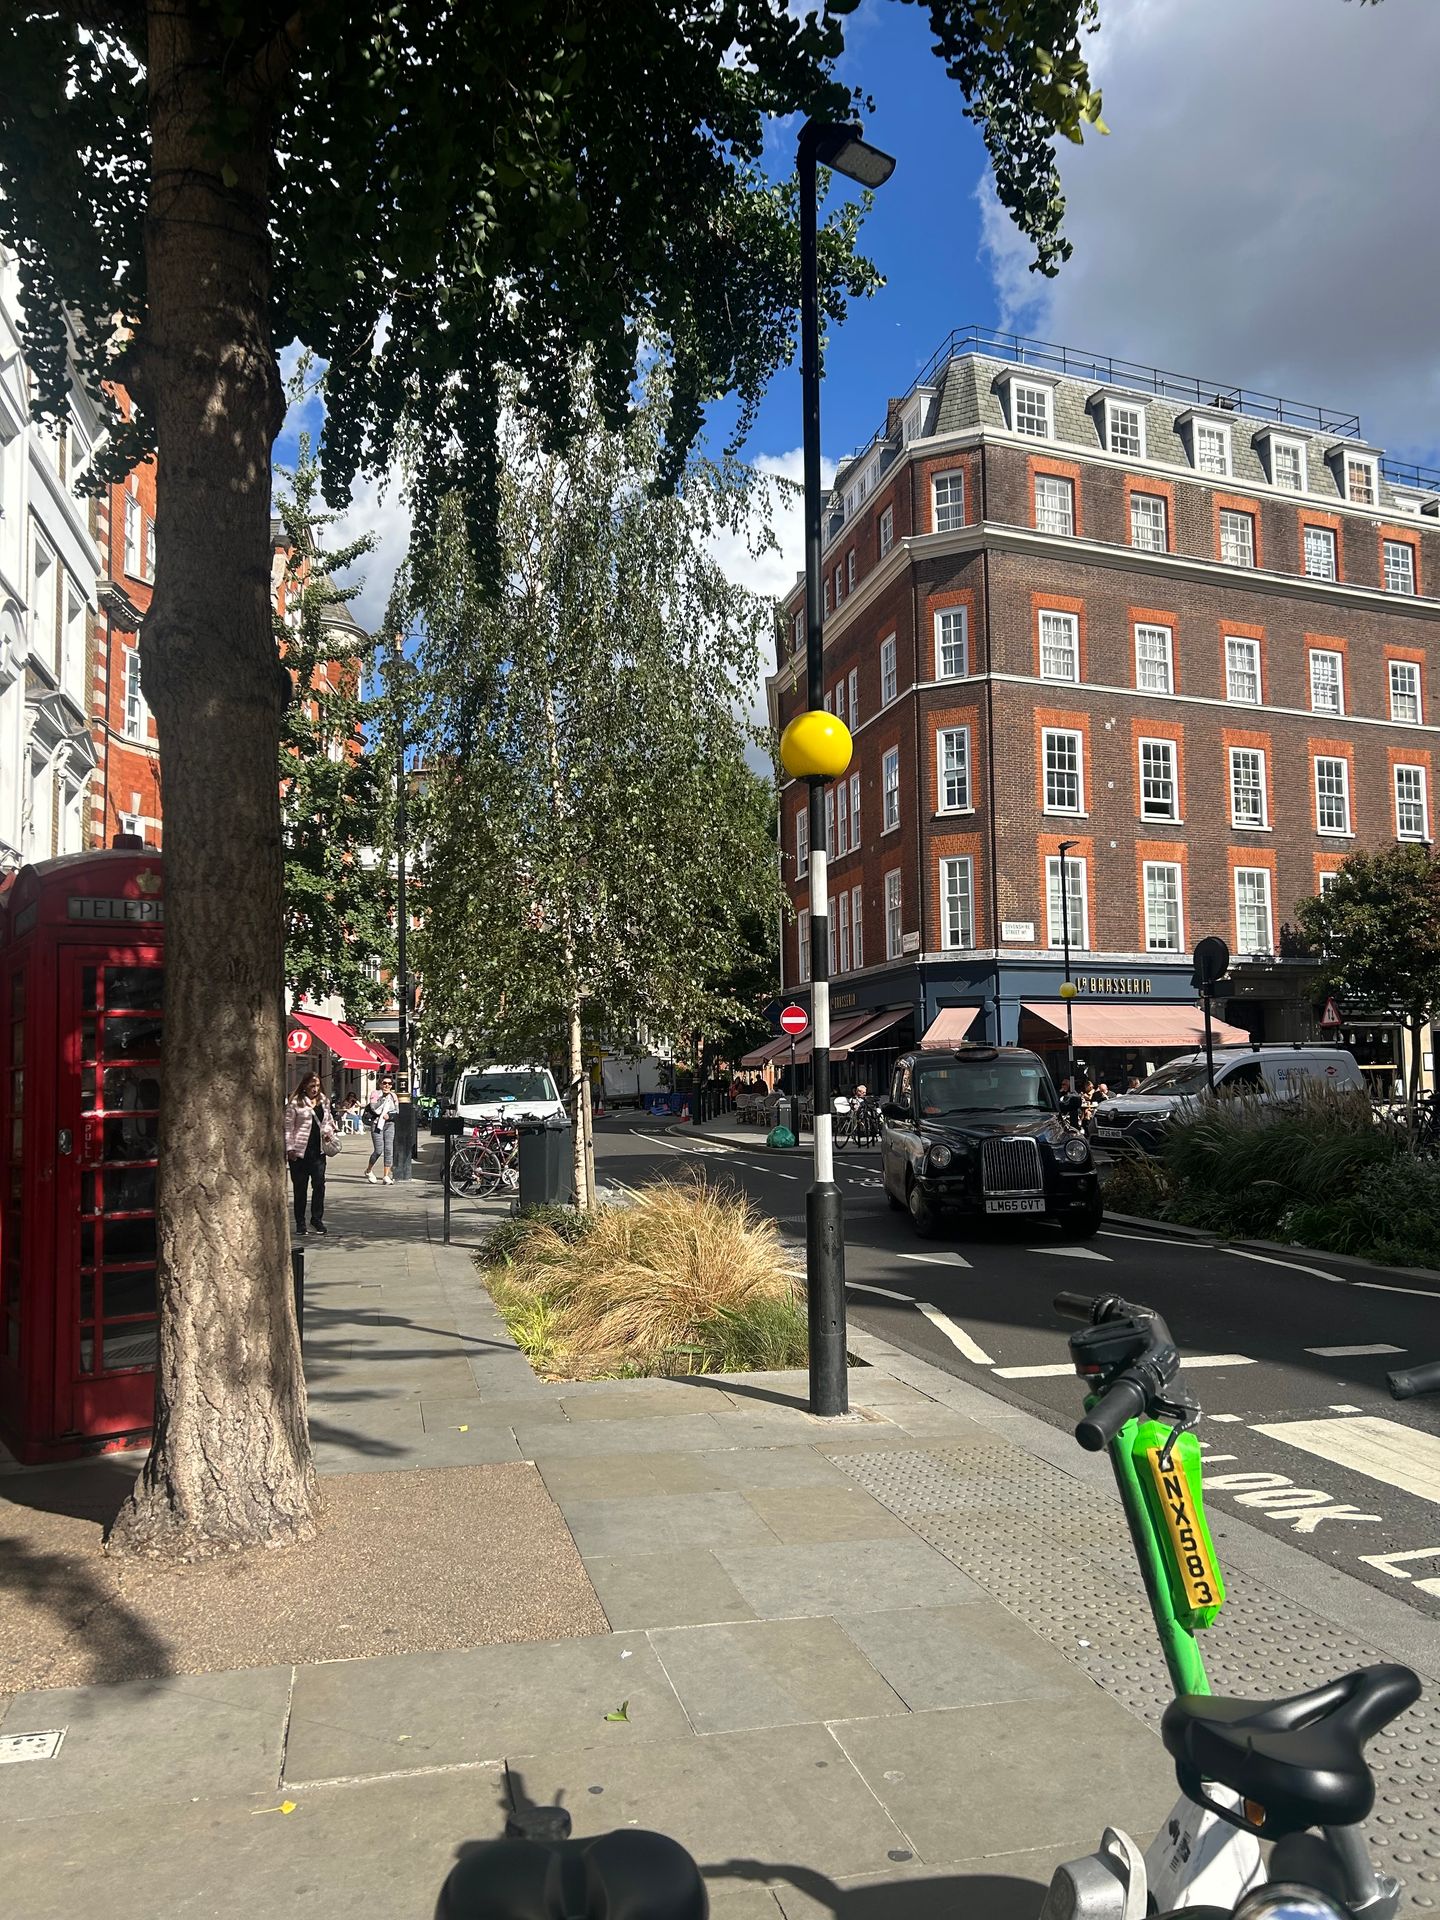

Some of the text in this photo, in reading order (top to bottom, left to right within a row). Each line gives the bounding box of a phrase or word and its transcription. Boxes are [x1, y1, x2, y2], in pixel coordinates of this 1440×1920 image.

[1090, 977, 1151, 994] BRASSERIA
[990, 1200, 1041, 1211] LM65 GVT
